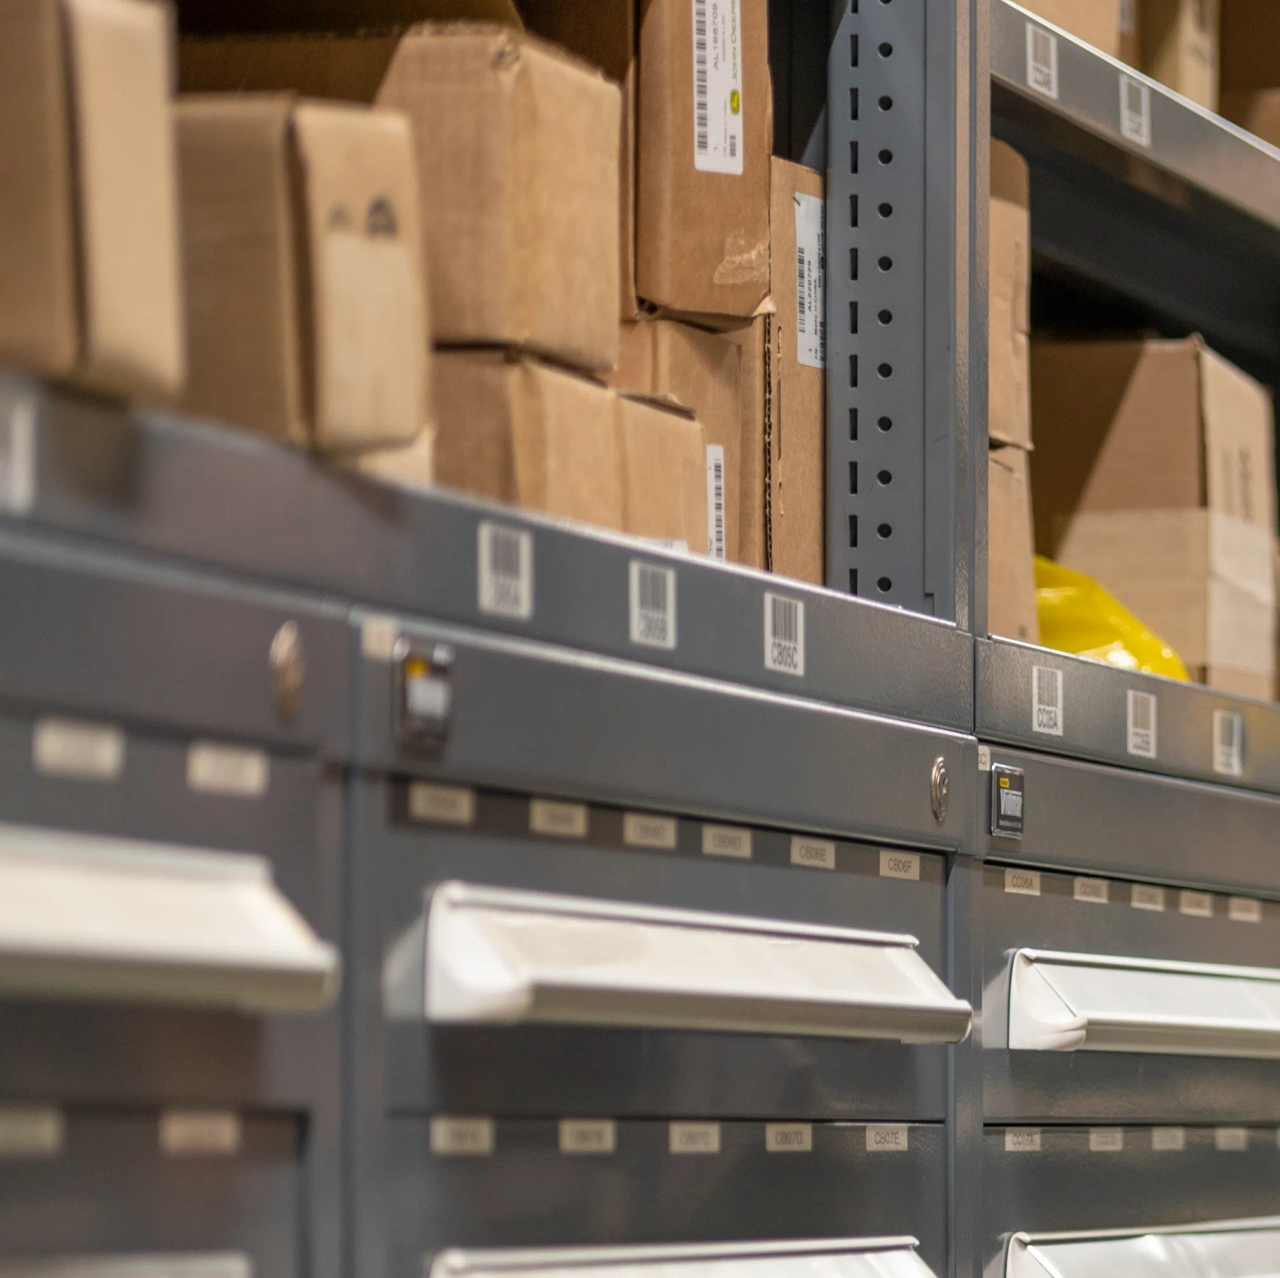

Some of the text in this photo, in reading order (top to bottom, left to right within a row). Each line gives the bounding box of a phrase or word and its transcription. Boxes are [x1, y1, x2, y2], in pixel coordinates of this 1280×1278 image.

[771, 641, 799, 670] CB05C
[887, 857, 913, 873] CB06F
[874, 1131, 901, 1146] CB07E
